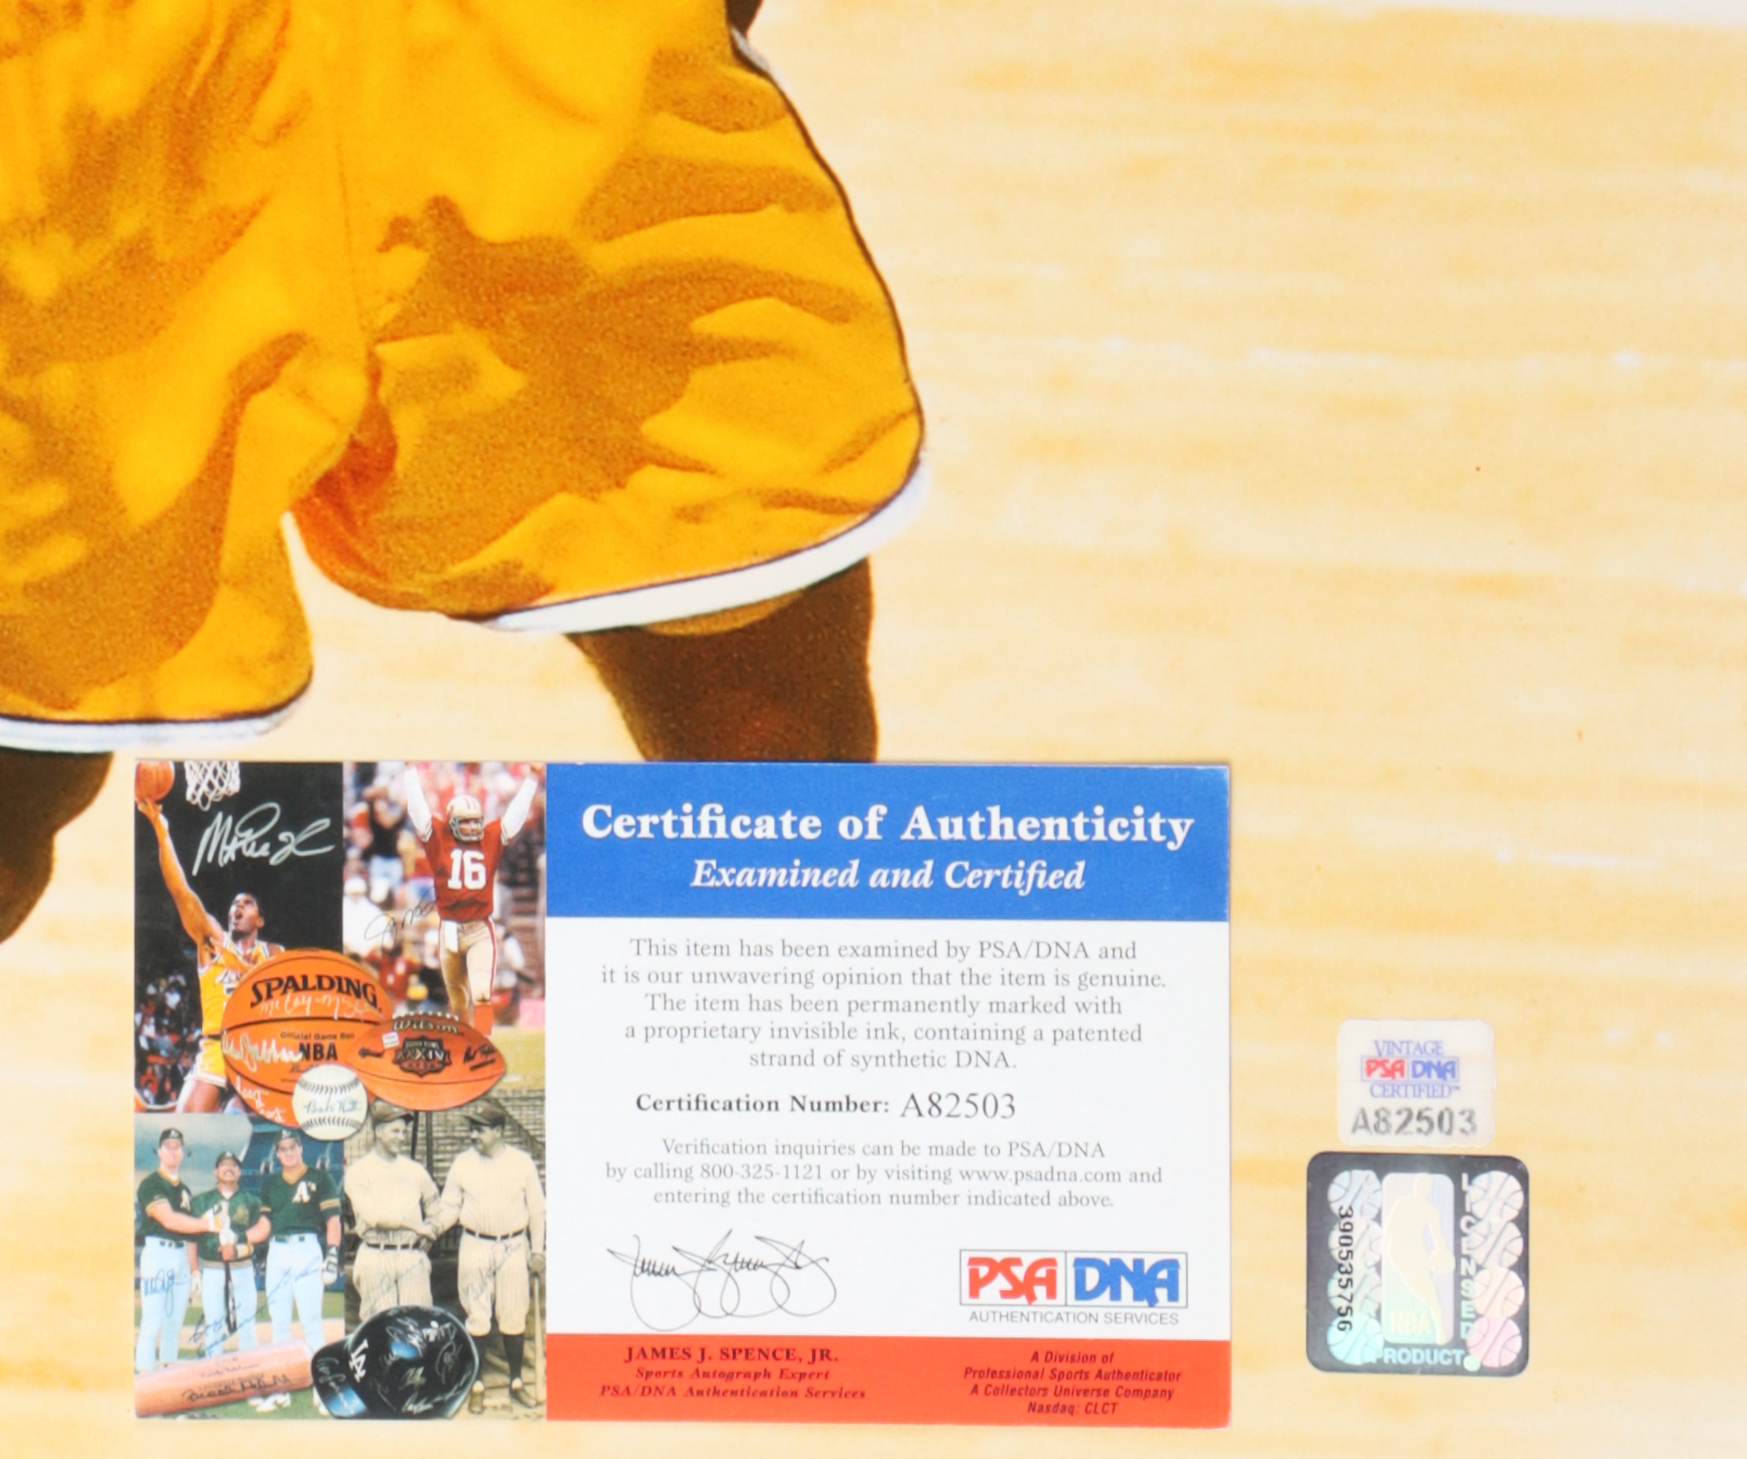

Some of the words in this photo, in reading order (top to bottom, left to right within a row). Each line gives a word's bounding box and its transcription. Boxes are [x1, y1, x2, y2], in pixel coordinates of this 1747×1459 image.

[581, 801, 823, 841] Certificate
[837, 803, 888, 841] of
[899, 804, 1195, 851] Authenticity
[447, 848, 487, 891] 16
[690, 858, 860, 889] Examined
[868, 858, 935, 889] and
[944, 859, 1086, 896] Certified
[629, 937, 678, 956] This
[686, 938, 731, 957] item
[739, 938, 774, 957] has
[781, 938, 830, 958] been
[837, 939, 938, 959] examined
[946, 939, 970, 963] by
[979, 940, 1090, 959] PSA/DNA
[1098, 940, 1137, 960] and
[602, 965, 615, 984] it
[624, 965, 640, 983] is
[647, 971, 683, 984] our
[691, 966, 815, 990] unwavering
[821, 966, 903, 990] opinion
[911, 966, 952, 986] that
[960, 967, 992, 986] the
[1000, 967, 1046, 987] item
[1054, 968, 1071, 987] is
[1077, 968, 1166, 992] genuine.
[250, 974, 378, 1009] SPALDING
[644, 992, 686, 1012] The
[695, 993, 740, 1012] item
[748, 993, 783, 1012] has
[790, 993, 839, 1013] been
[847, 994, 980, 1018] permanently
[988, 994, 1066, 1014] marked
[1074, 995, 1122, 1015] with
[314, 1032, 337, 1041] Game
[625, 1025, 636, 1039] a
[644, 1020, 762, 1044] proprietary
[770, 1021, 858, 1040] invisible
[866, 1021, 906, 1043] ink,
[913, 1022, 1026, 1046] containing
[1033, 1028, 1044, 1042] a
[1052, 1023, 1142, 1047] patented
[299, 1043, 338, 1061] NBA
[1374, 1039, 1445, 1057] VINTAGE
[749, 1048, 815, 1067] strand
[823, 1048, 846, 1067] of
[851, 1048, 946, 1072] synthetic
[955, 1050, 1016, 1069] DNA.
[1365, 1059, 1406, 1080] PSA
[1411, 1060, 1457, 1081] DNA
[635, 1093, 780, 1112] Certification
[790, 1094, 889, 1113] Number:
[901, 1092, 1016, 1119] A82503
[1351, 1107, 1478, 1136] A82503
[662, 1138, 767, 1155] Verification
[774, 1139, 856, 1160] inquiries
[862, 1144, 894, 1156] can
[900, 1139, 921, 1156] be
[928, 1140, 976, 1157] made
[983, 1143, 1001, 1157] to
[1008, 1140, 1106, 1158] PSA/DNA
[606, 1161, 627, 1183] by
[633, 1162, 694, 1183] calling
[700, 1163, 822, 1180] 800-325-1121
[830, 1168, 850, 1180] or
[856, 1163, 878, 1185] by
[884, 1164, 953, 1185] visiting
[958, 1165, 1122, 1186] www.psadna.com
[1128, 1166, 1163, 1184] and
[653, 1187, 731, 1208] entering
[737, 1187, 765, 1204] the
[771, 1187, 882, 1205] certification
[889, 1188, 960, 1206] number
[967, 1189, 1051, 1207] indicated
[1057, 1189, 1114, 1208] above.
[1337, 1204, 1354, 1332] 390535756
[967, 1256, 1058, 1305] PSA
[1073, 1257, 1180, 1307] DNA
[969, 1310, 1099, 1324] AUTHENTICATION
[1103, 1312, 1179, 1325] SERVICES
[624, 1346, 692, 1363] JAMES
[697, 1346, 712, 1363] J.
[719, 1347, 803, 1364] SPENCE,
[807, 1348, 840, 1365] JR.
[1030, 1350, 1039, 1362] A
[1044, 1350, 1097, 1364] Division
[1101, 1352, 1114, 1364] of
[635, 1367, 684, 1381] Sports
[690, 1367, 772, 1382] Autograph
[778, 1368, 831, 1382] Expert
[964, 1366, 1045, 1380] Professional
[1049, 1367, 1090, 1382] Sports
[1095, 1368, 1180, 1381] Authenticator
[600, 1384, 677, 1397] PSA/DNA
[683, 1385, 799, 1399] Authentication
[805, 1386, 867, 1399] Services
[971, 1384, 979, 1395] A
[984, 1383, 1048, 1397] Collectors
[1053, 1385, 1110, 1398] Universe
[1115, 1385, 1174, 1400] Company
[1027, 1401, 1080, 1415] Nasdaq:
[1084, 1402, 1117, 1415] CLCT
